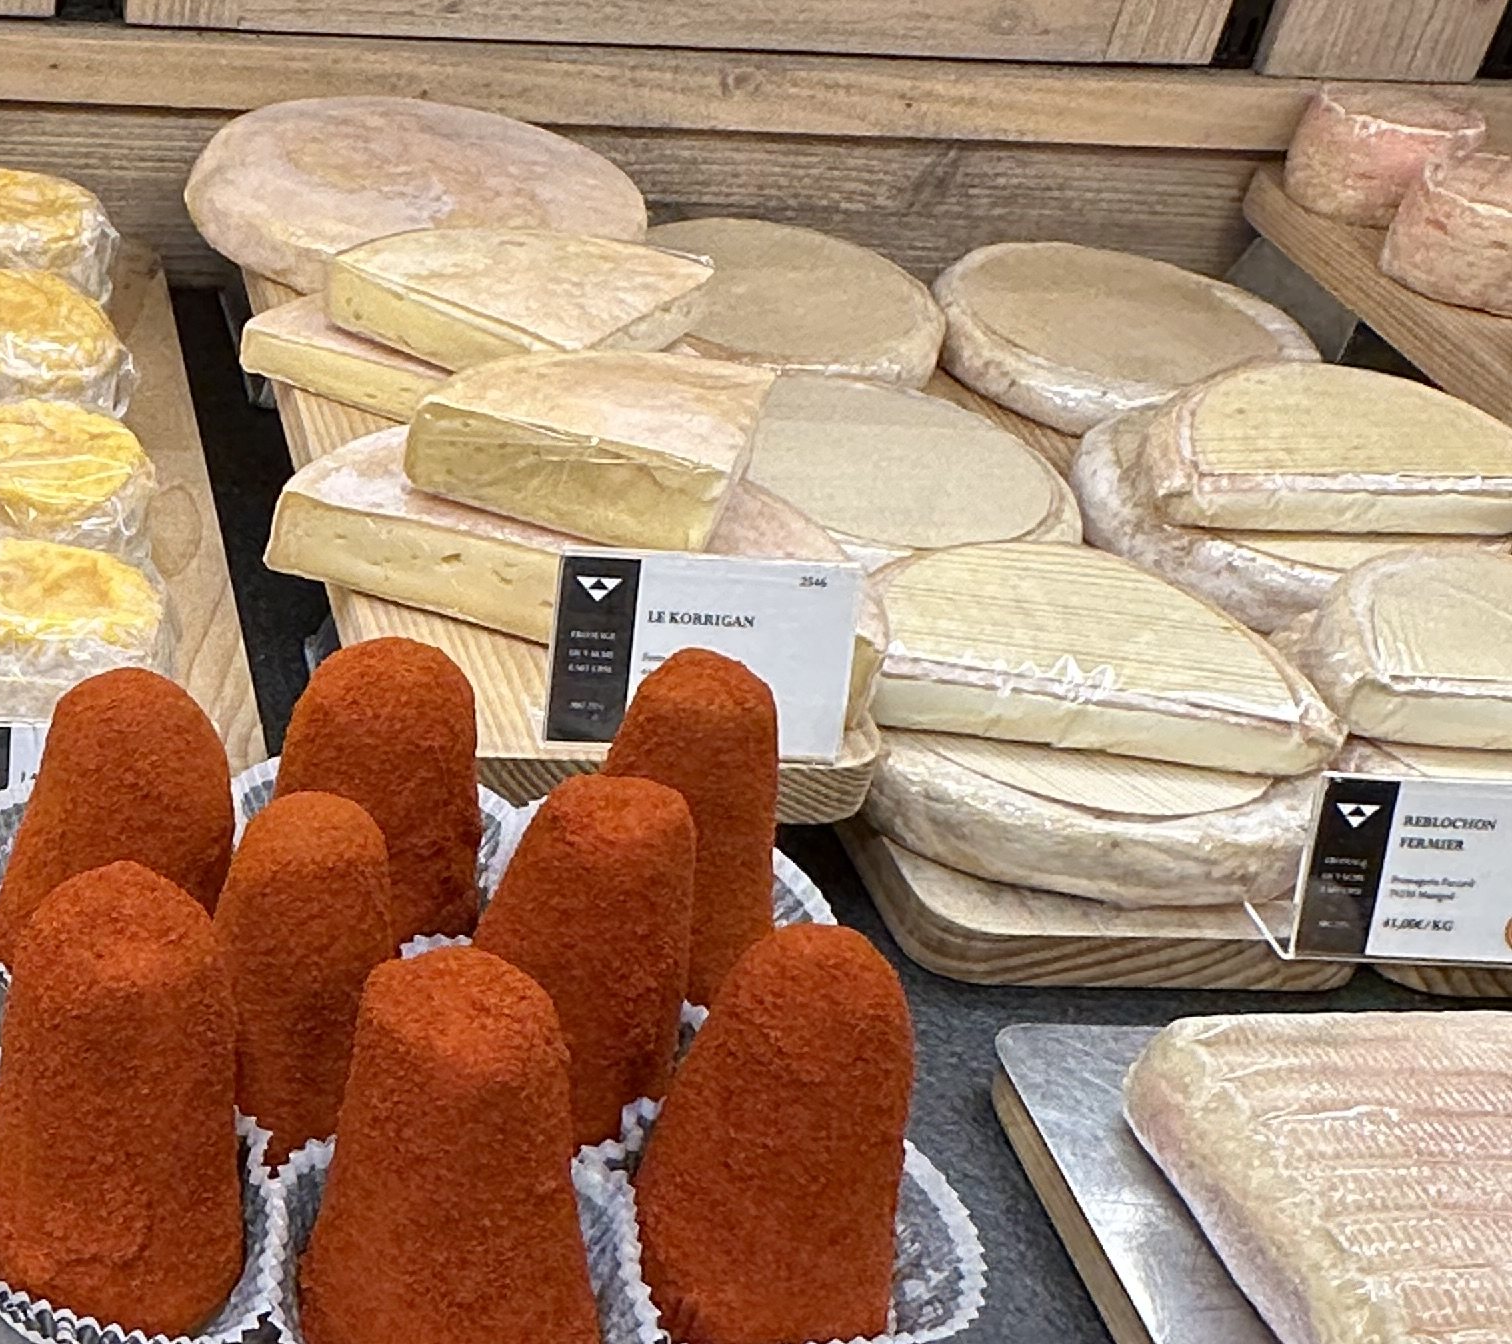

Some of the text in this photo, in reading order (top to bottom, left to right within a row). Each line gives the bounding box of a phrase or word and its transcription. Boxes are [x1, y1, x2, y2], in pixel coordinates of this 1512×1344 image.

[647, 610, 755, 628] LE KORRIGAN
[1402, 815, 1497, 832] REBLOCHON
[1399, 836, 1465, 851] FERMIER
